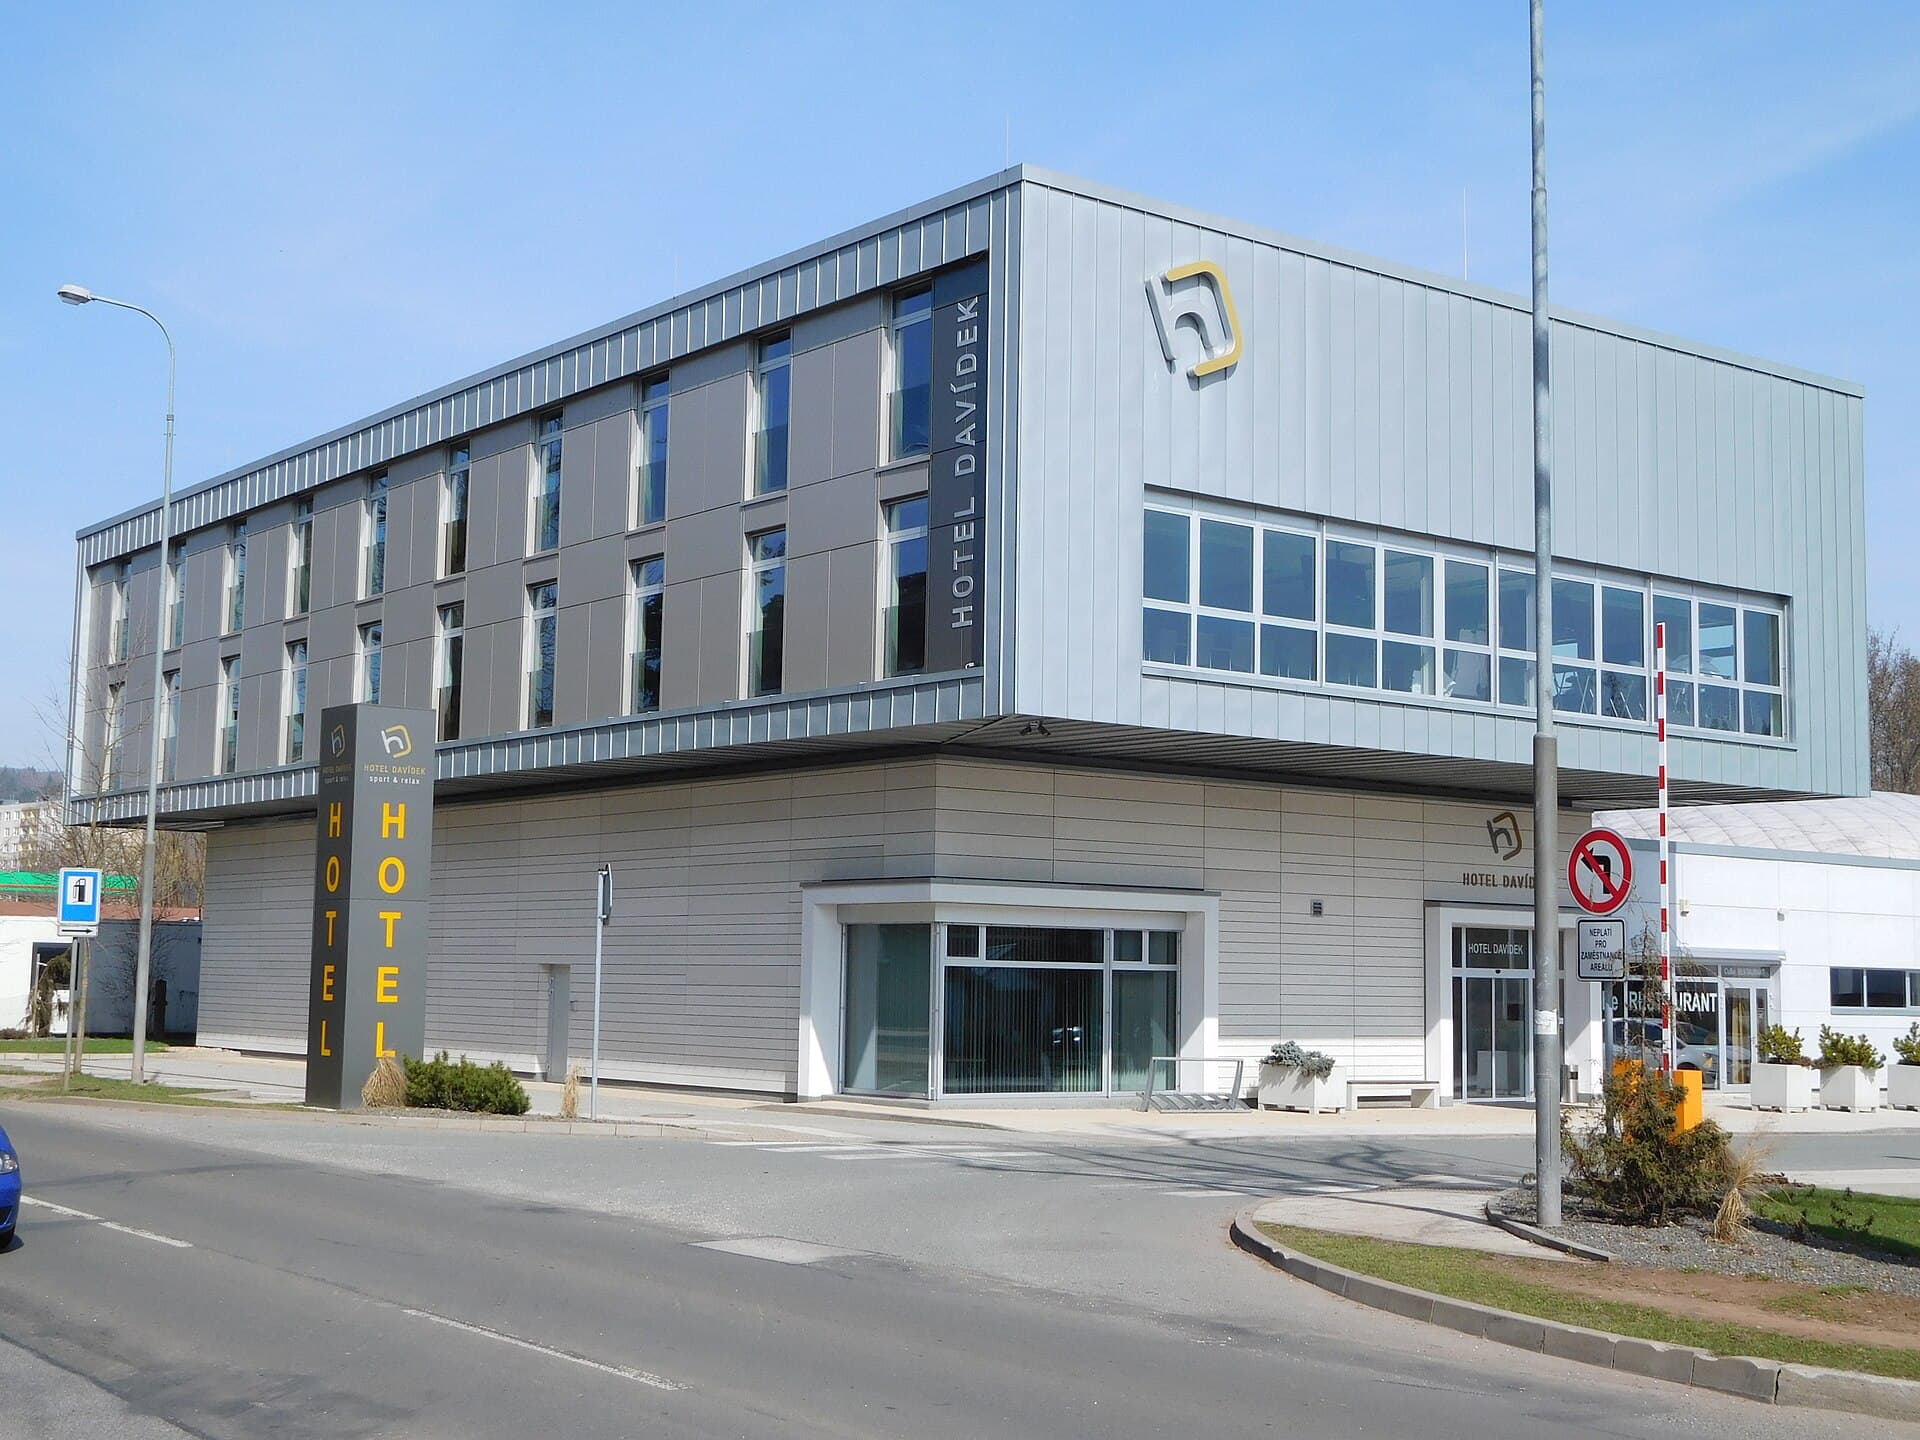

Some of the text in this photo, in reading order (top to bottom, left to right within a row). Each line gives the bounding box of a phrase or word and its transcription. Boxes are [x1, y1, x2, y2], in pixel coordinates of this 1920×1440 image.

[950, 296, 979, 629] HOTEL DAVÍDEK
[364, 763, 389, 774] HOTEL
[392, 765, 426, 775] DAVÍDEK
[369, 775, 420, 785] sport & relax
[1463, 872, 1535, 889] HOTEL DAVÍD
[320, 803, 342, 1057] HOTEL
[375, 803, 406, 1058] HOTEL
[1468, 943, 1491, 954] HOTEL
[1595, 940, 1606, 948] PRO
